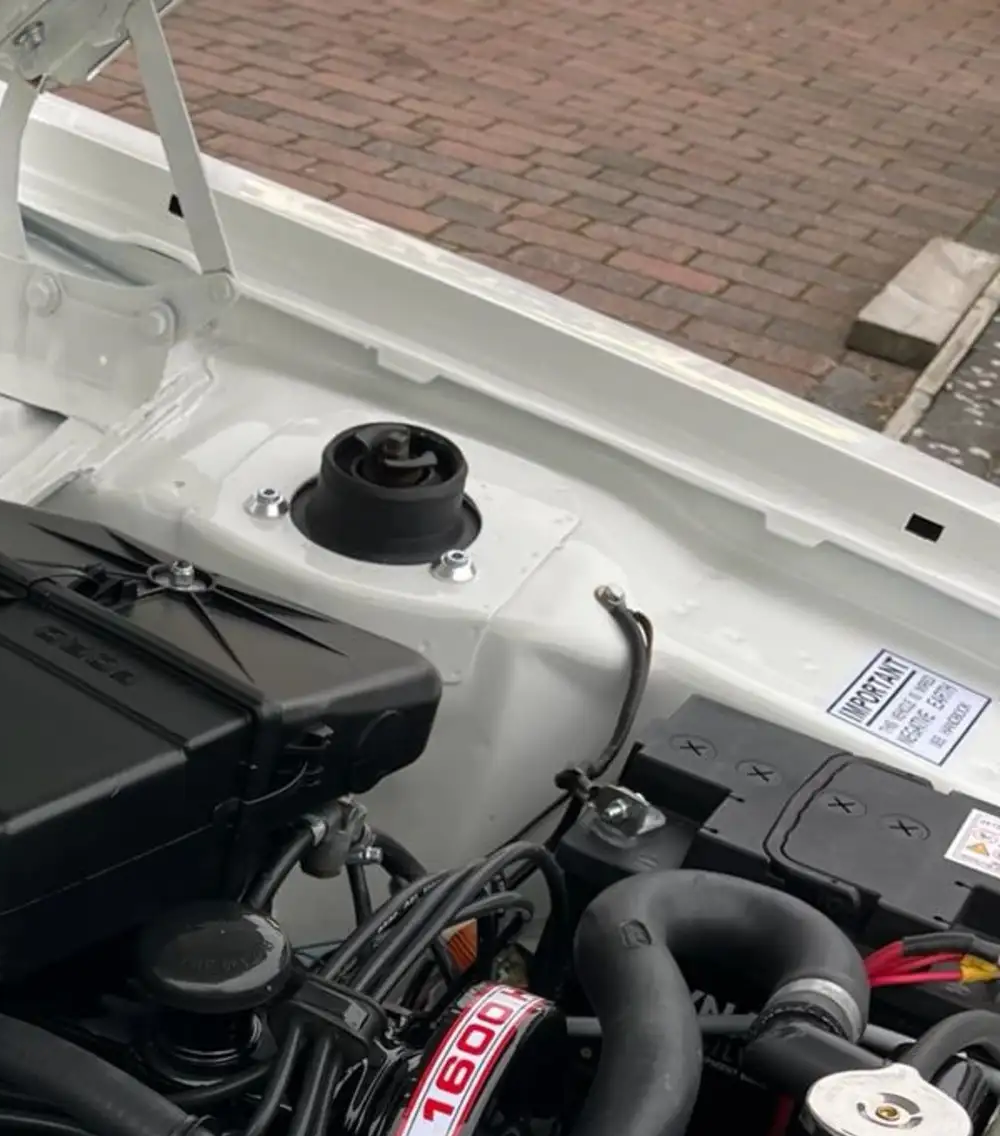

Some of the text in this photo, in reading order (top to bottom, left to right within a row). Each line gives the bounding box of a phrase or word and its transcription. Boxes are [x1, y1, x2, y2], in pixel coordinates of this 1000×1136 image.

[837, 656, 909, 723] IMPORTANT
[925, 682, 959, 711] EARTH
[422, 1001, 514, 1122] 1600
